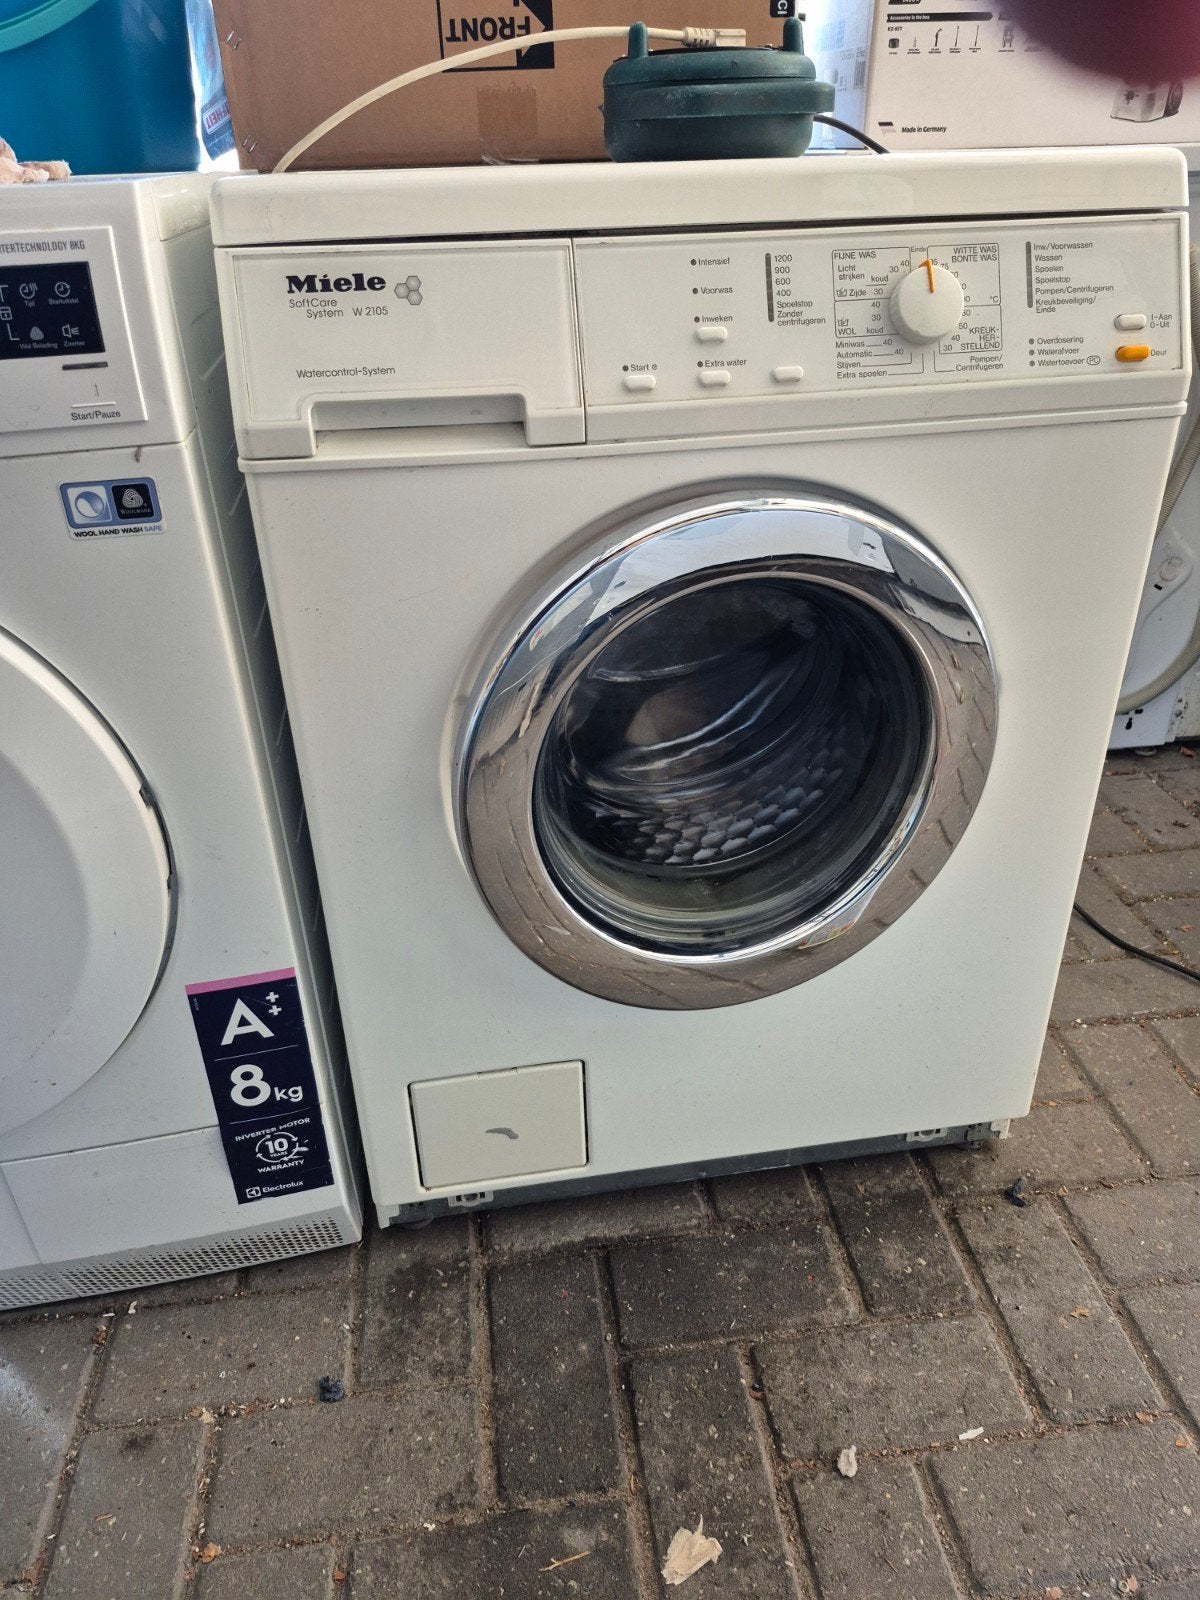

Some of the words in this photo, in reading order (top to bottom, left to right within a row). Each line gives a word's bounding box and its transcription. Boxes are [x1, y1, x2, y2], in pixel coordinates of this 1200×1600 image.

[446, 16, 531, 43] FRONT
[70, 240, 85, 250] 8KG
[774, 254, 793, 262] 1200
[834, 252, 856, 260] FIJNE
[858, 251, 876, 259] WAS
[951, 255, 978, 263] BONTE
[979, 254, 997, 262] WAS
[1034, 254, 1063, 262] Wassen
[698, 257, 730, 266] Intensief
[774, 266, 791, 274] 900
[838, 264, 856, 273] Licht
[889, 265, 899, 273] 30
[1034, 265, 1064, 273] Spoelen
[838, 273, 865, 281] strijken
[1035, 276, 1071, 285] Spoelstop
[286, 273, 386, 294] Miele
[700, 286, 733, 295] Voorwas
[776, 289, 792, 297] 400
[849, 288, 867, 297] Zijde
[1035, 285, 1115, 296] Pompen/Centrifugeren
[289, 298, 338, 308] SoftCare
[989, 295, 999, 303] °C
[1036, 296, 1097, 306] Kreukbeveiliging/
[776, 300, 813, 309] Spoelstop
[306, 309, 344, 319] System
[352, 308, 363, 316] W
[366, 306, 389, 316] 2105
[777, 310, 803, 318] Zonder
[1036, 306, 1056, 314] Einde
[702, 314, 733, 323] Inweken
[777, 317, 826, 327] centrifugeren
[838, 327, 857, 335] WOL
[866, 326, 884, 334] koud
[969, 326, 1000, 335] KREUK-
[950, 334, 960, 342] 40
[1037, 336, 1084, 345] Overdosering
[835, 341, 865, 349] Miniwas
[883, 338, 893, 346] 40
[942, 344, 953, 352] 30
[960, 342, 1001, 351] STELLEND
[836, 351, 873, 359] Automatic
[1037, 347, 1079, 356] Waterafvoer
[1150, 349, 1167, 357] Deur
[705, 360, 725, 368] Extra
[726, 358, 747, 367] water
[969, 354, 1003, 363] Pompen/
[1037, 358, 1085, 367] Watertoevoer
[630, 364, 649, 372] Start
[836, 361, 861, 370] Stijven
[955, 363, 1004, 372] Centrifugeren
[296, 367, 396, 378] Watercontrol-System
[837, 371, 856, 379] Extra
[858, 369, 888, 378] spoelen
[71, 410, 121, 420] Start/Pauze
[99, 527, 120, 535] HAND
[235, 1127, 276, 1141] INVERTER
[279, 1117, 310, 1130] MOTOR
[265, 1138, 288, 1154] 10
[257, 1159, 304, 1173] WARRANTY
[262, 1181, 303, 1193] Electrolux
